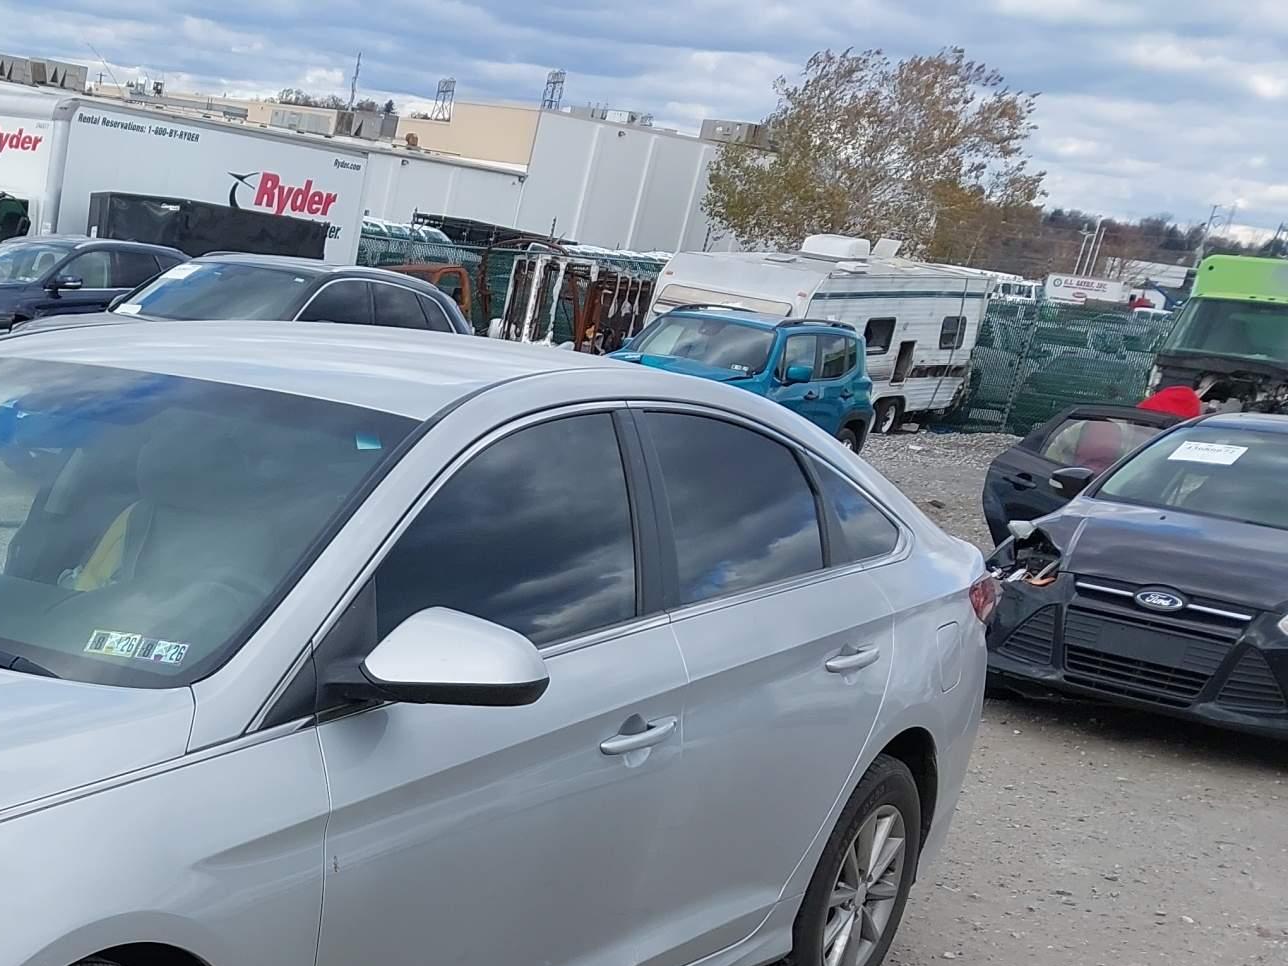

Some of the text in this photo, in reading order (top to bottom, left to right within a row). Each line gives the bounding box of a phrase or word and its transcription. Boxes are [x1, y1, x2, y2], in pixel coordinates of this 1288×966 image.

[78, 112, 100, 125] Rental
[101, 117, 146, 134] Reservations:
[333, 158, 362, 171] Ryder.com
[254, 171, 338, 216] Ryder
[1145, 593, 1173, 606] Ford
